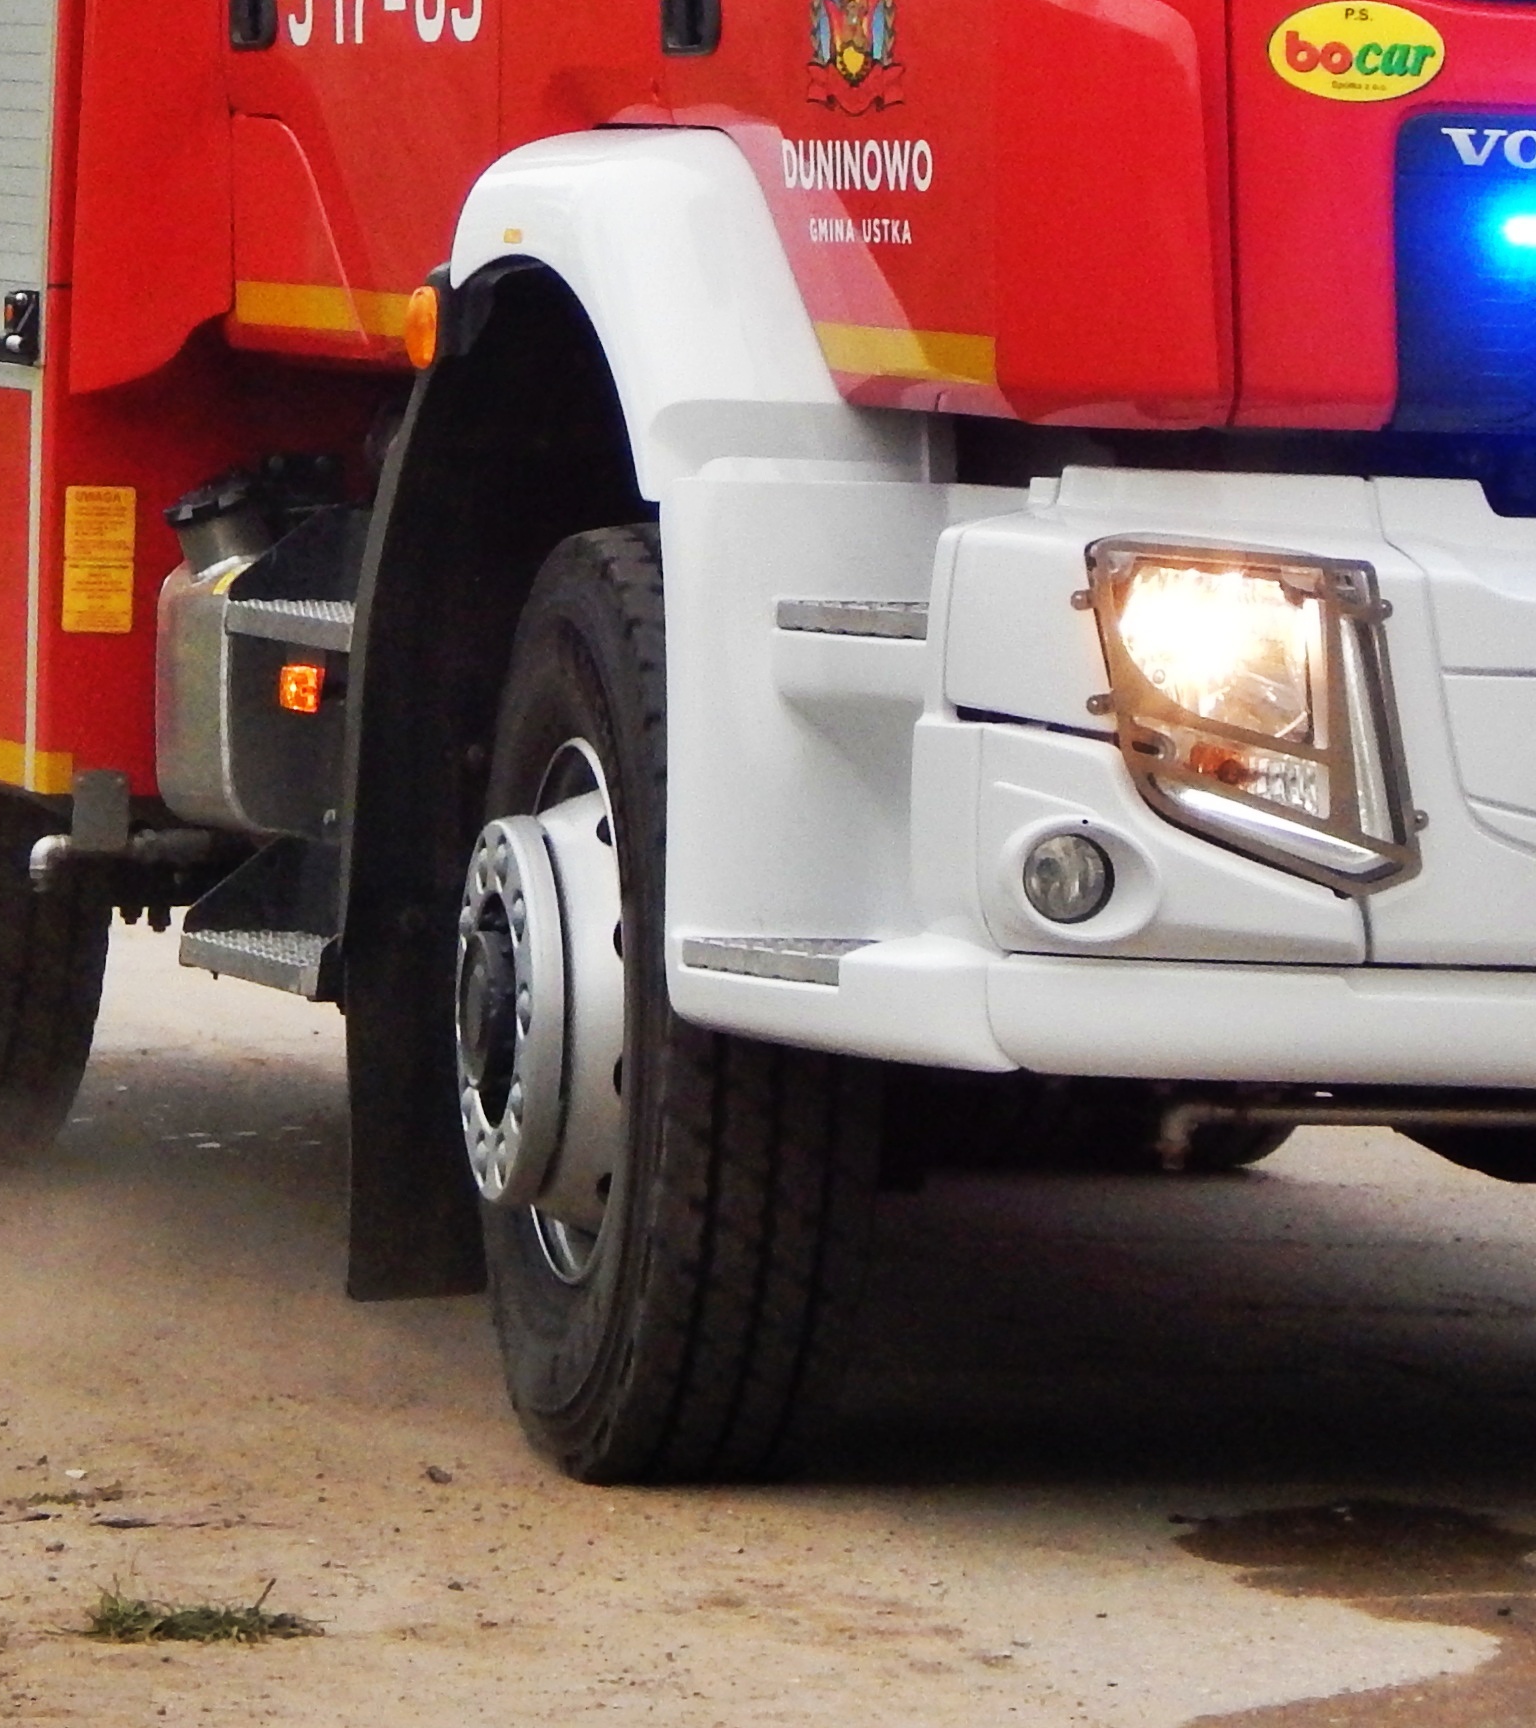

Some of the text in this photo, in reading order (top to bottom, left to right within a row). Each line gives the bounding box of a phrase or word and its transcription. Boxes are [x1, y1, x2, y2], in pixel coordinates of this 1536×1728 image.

[1285, 30, 1436, 77] bocar
[781, 139, 933, 191] DUNINOWO
[810, 218, 912, 245] GMINA USTKA
